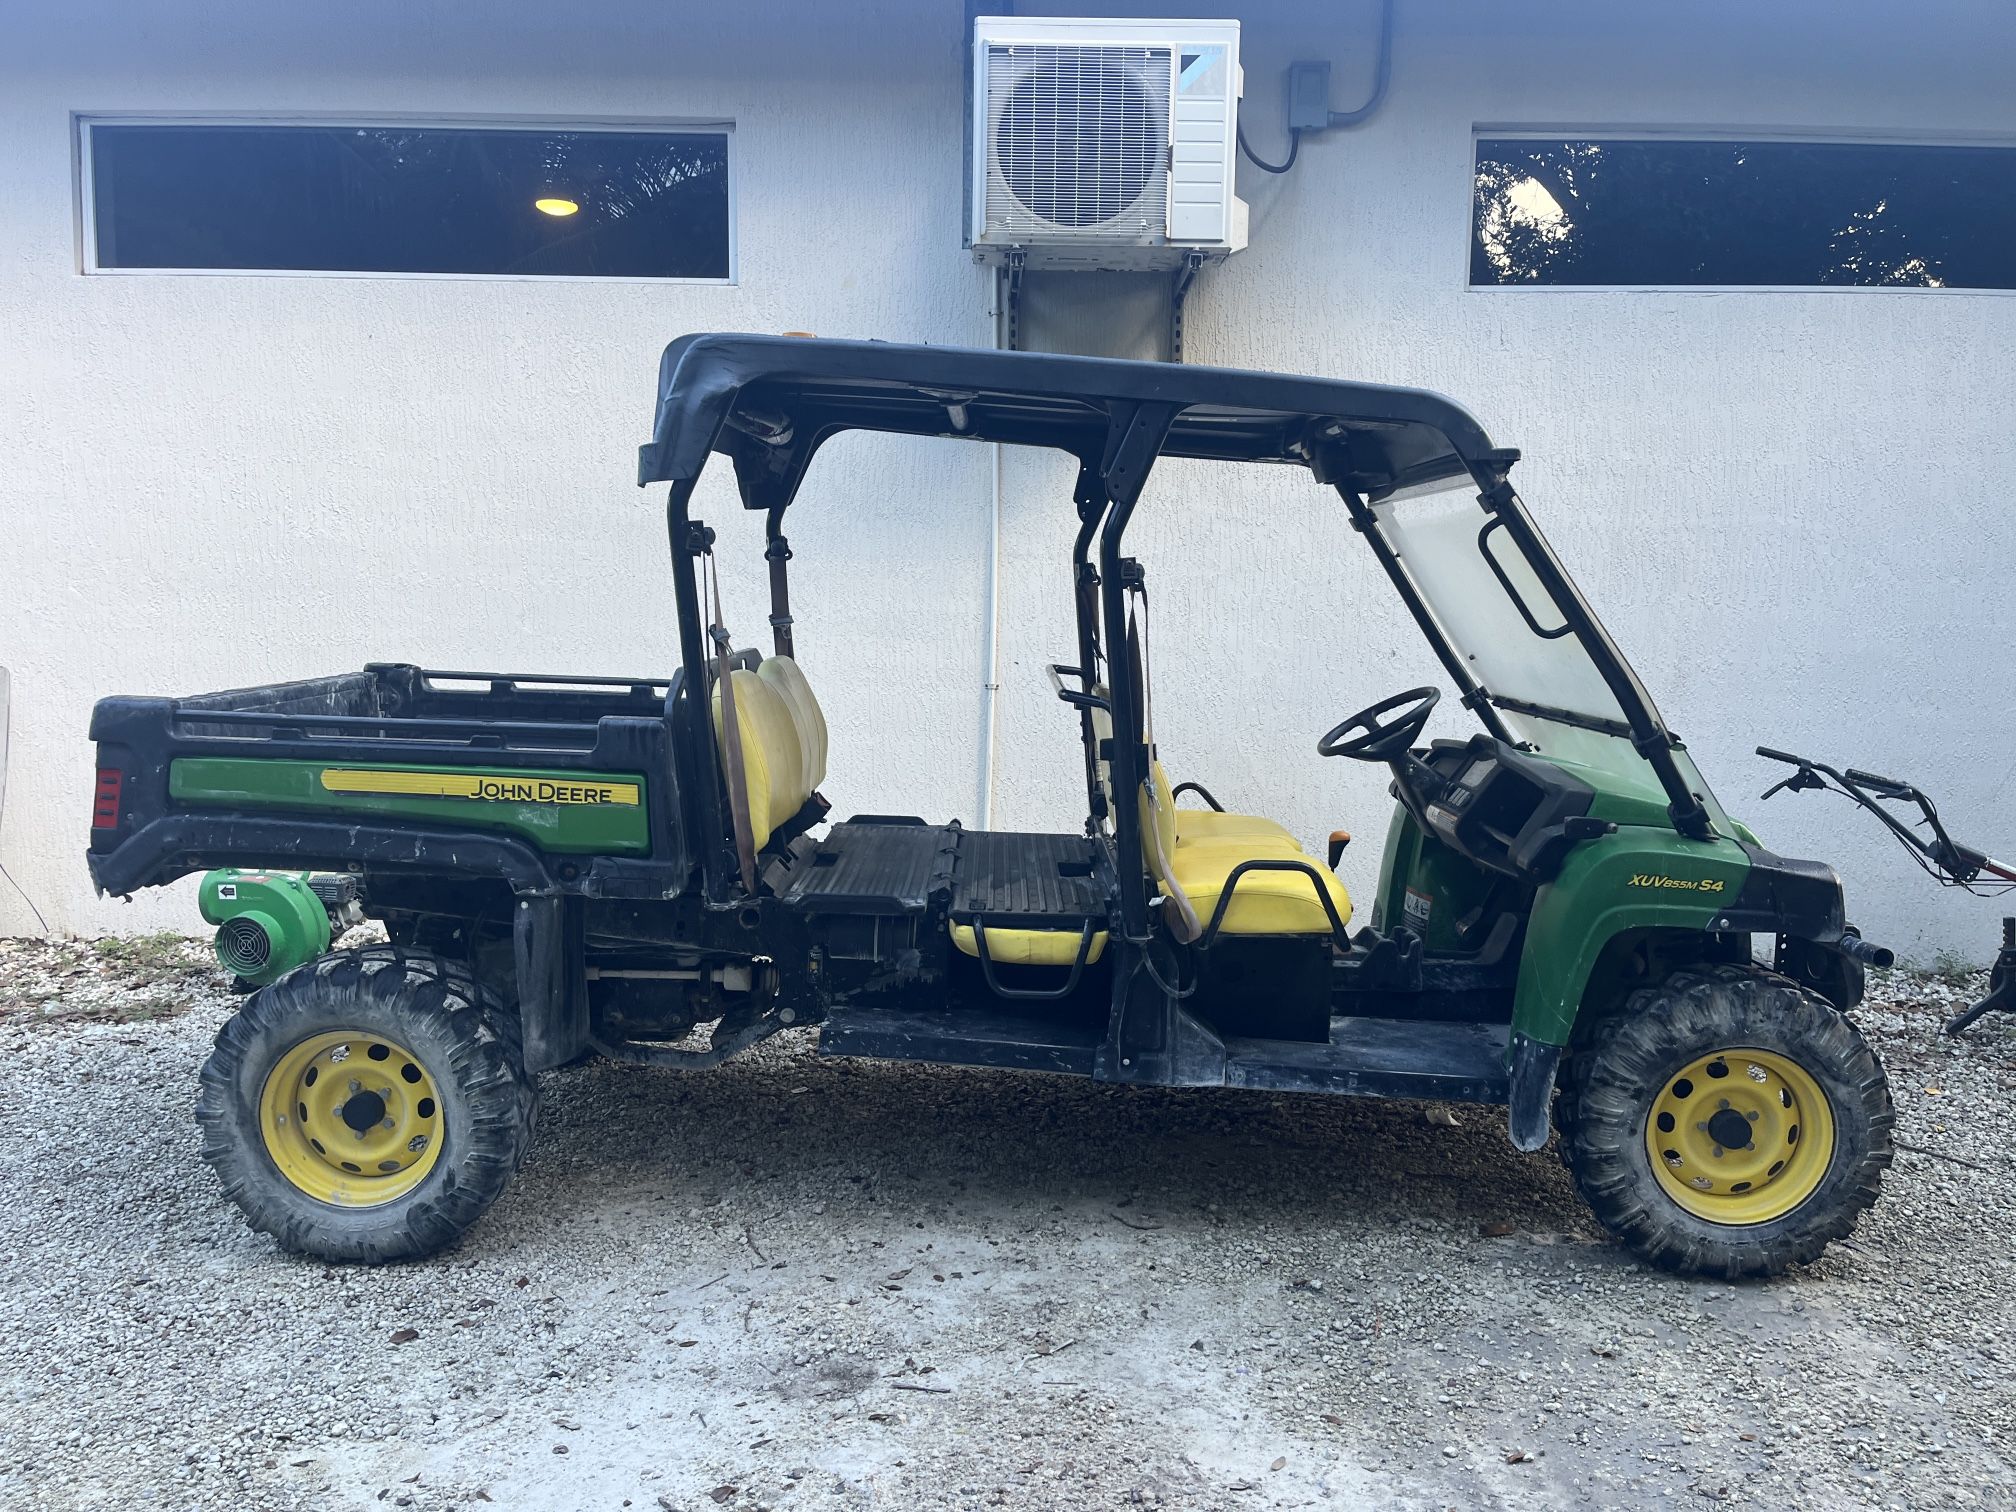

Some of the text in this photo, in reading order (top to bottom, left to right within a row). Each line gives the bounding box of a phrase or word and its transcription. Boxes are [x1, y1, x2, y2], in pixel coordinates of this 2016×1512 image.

[470, 780, 612, 802] JOHN DEERE
[1699, 880, 1724, 892] S4
